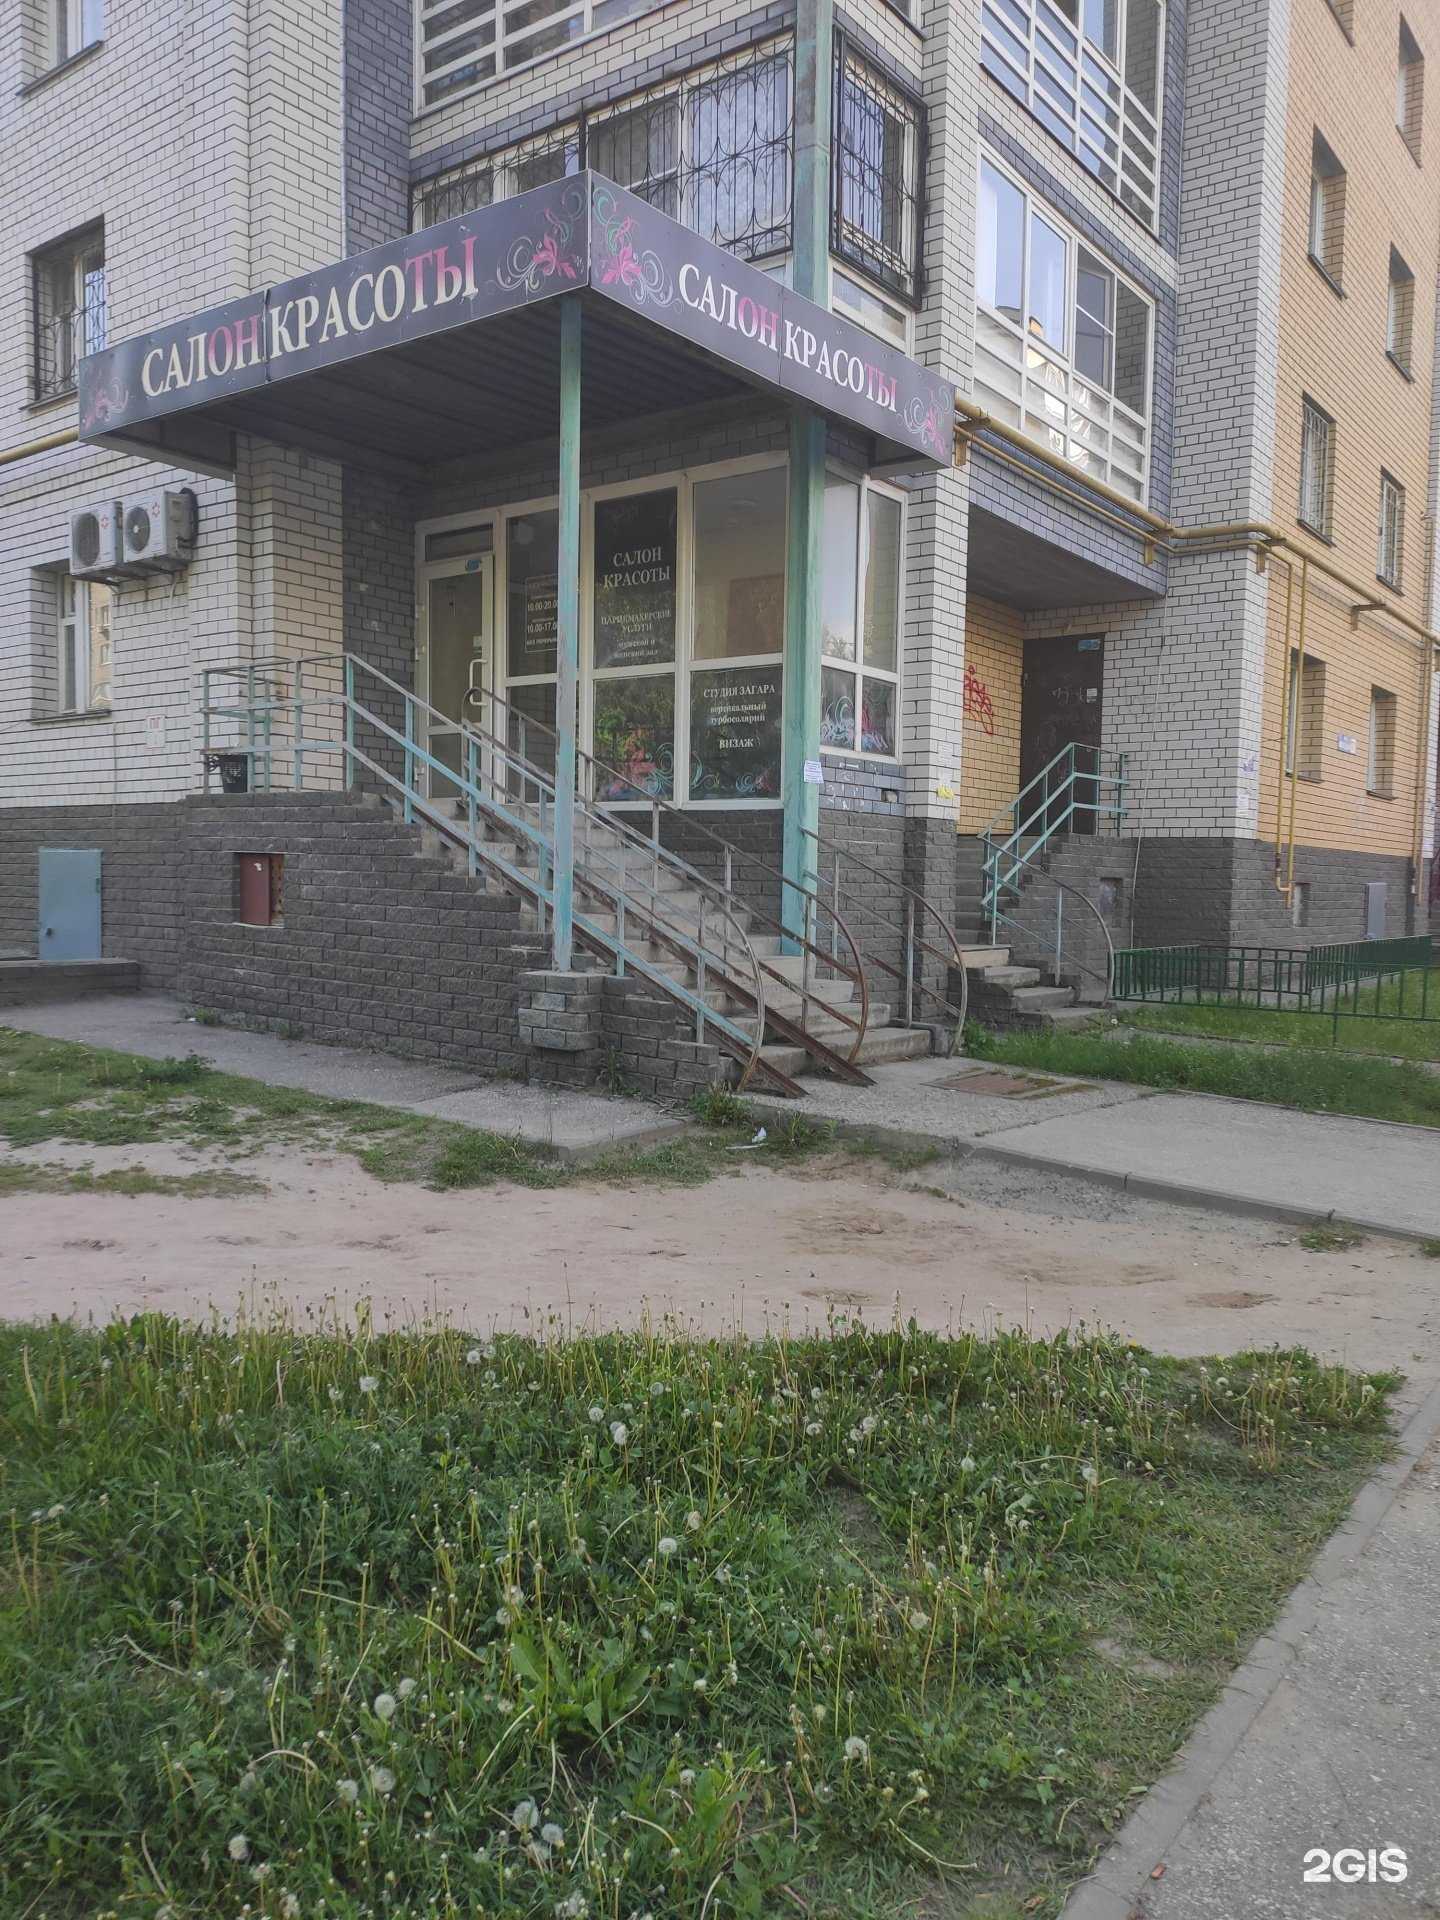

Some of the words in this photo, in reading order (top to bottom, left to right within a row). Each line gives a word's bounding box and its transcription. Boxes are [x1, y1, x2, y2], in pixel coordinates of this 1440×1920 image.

[141, 313, 265, 397] САЛОН
[269, 236, 479, 358] КРАСОТЫ
[678, 263, 779, 351] САЛОН
[783, 319, 898, 412] КРАСОТЫ
[612, 545, 662, 568] САЛОН
[602, 565, 671, 589] КРАСОТЫ
[703, 686, 738, 698] СТУДИЯ
[739, 684, 776, 696] ЗАГАРА
[719, 738, 755, 750] ВИЗАЖ
